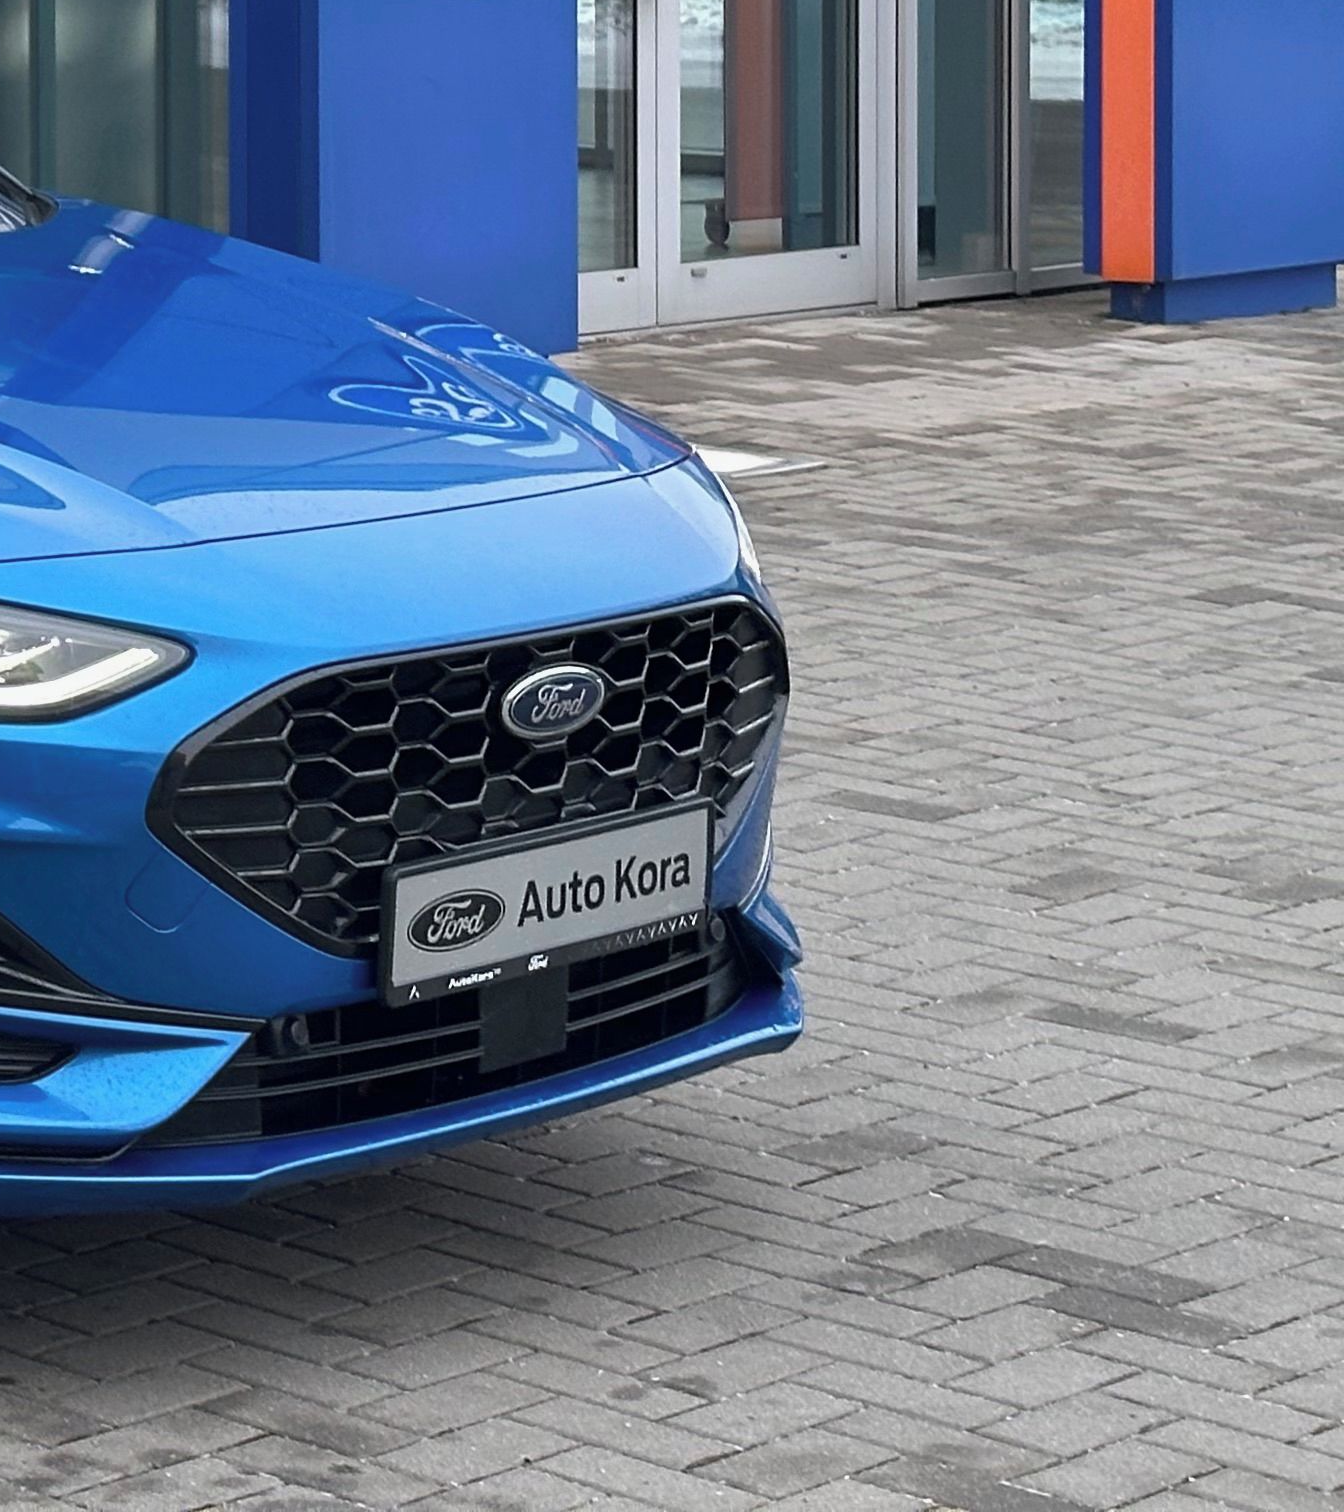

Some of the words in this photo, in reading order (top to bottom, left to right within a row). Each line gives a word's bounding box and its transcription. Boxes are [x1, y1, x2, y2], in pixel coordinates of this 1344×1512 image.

[530, 682, 587, 724] Ford
[427, 898, 486, 944] Ford
[517, 870, 605, 927] Auto
[615, 852, 691, 903] Kora
